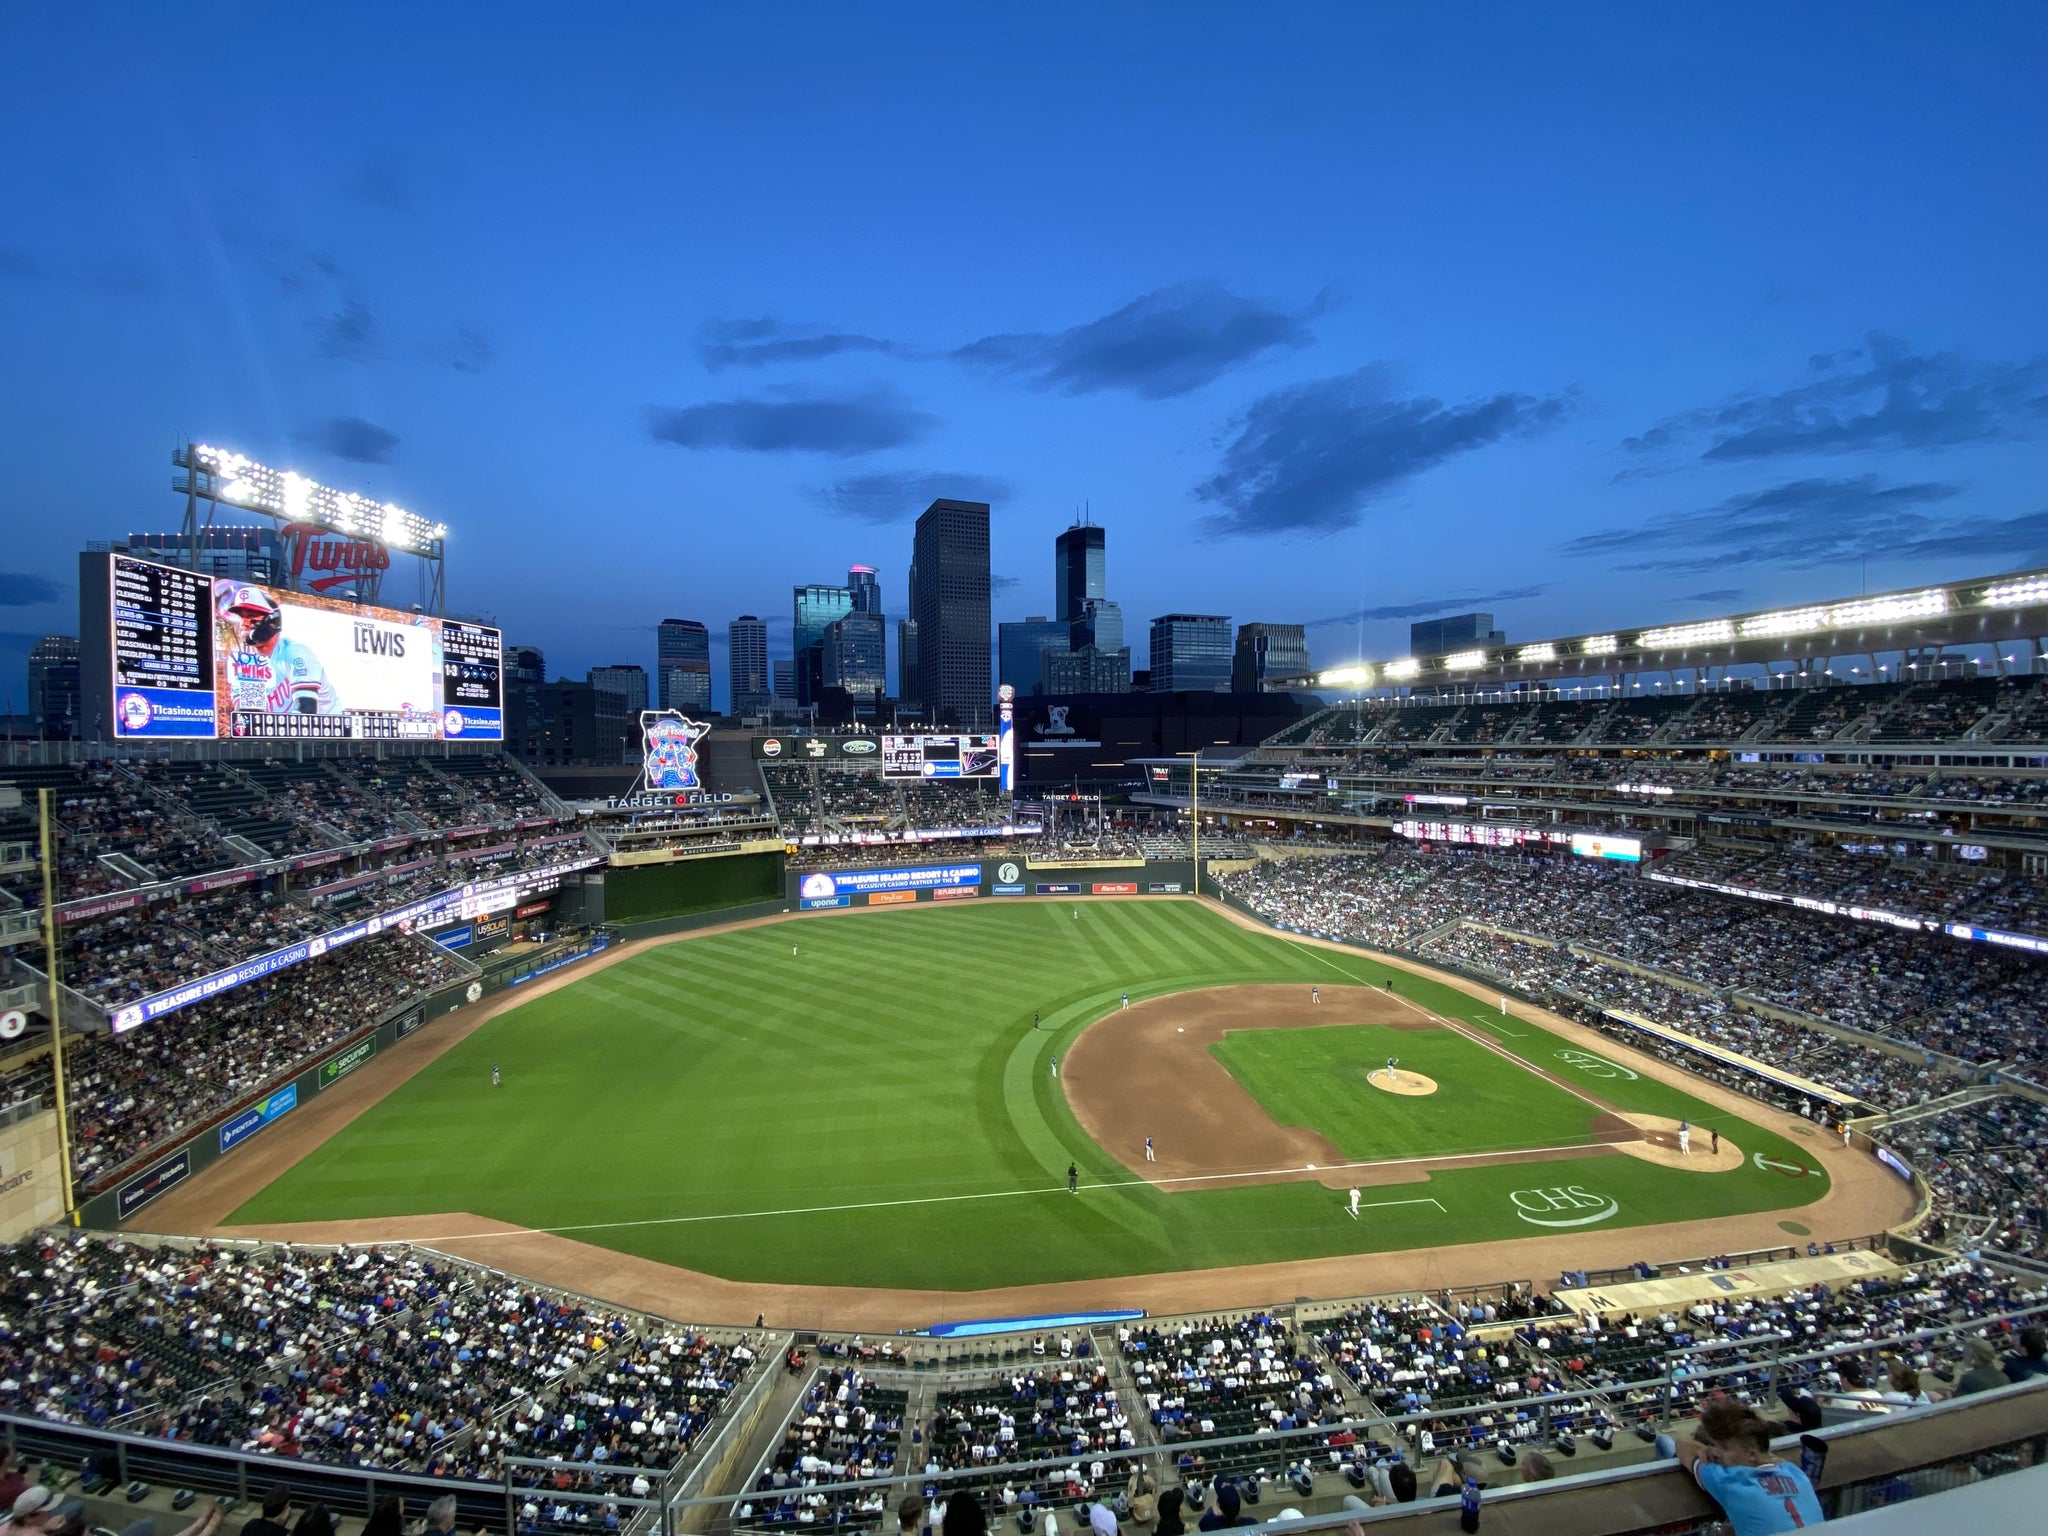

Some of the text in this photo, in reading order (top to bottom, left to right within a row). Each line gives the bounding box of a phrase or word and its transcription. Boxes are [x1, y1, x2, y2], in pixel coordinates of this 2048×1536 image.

[282, 522, 390, 576] Twins
[116, 570, 140, 580] MARTIN
[116, 580, 141, 590] BUXTON
[116, 590, 145, 600] CLEMENS
[117, 600, 132, 608] BELL
[354, 621, 374, 629] ROYCE
[117, 640, 153, 650] KEASCHALL
[354, 626, 405, 658] LEWIS
[232, 664, 272, 679] TWINS
[445, 664, 458, 677] 1-3
[152, 704, 214, 717] TIcasino.com
[255, 715, 260, 724] 1
[266, 715, 273, 724] 0
[278, 716, 285, 724] 0
[291, 716, 297, 725] 0
[302, 716, 308, 725] 0
[314, 717, 319, 725] 1
[324, 717, 330, 726] 0
[335, 718, 341, 726] 0
[255, 727, 261, 736] 1
[267, 727, 273, 736] 0
[279, 727, 286, 736] 0
[291, 727, 297, 736] 0
[302, 727, 308, 736] 0
[314, 727, 320, 736] 0
[324, 727, 330, 736] 0
[335, 729, 341, 737] 0
[849, 744, 870, 752] Ford
[609, 793, 732, 808] TARGET FIELD
[302, 854, 341, 868] Treasure Island
[202, 874, 248, 891] TIcasino.com
[836, 875, 880, 885] TREASURE
[880, 873, 910, 882] ISLAND
[911, 871, 942, 880] RESORT
[949, 869, 979, 877] CASINO
[64, 898, 135, 921] Treasure Island
[811, 898, 839, 908] uponor
[383, 911, 410, 927] TREASURE
[410, 904, 427, 916] ISLAND
[478, 925, 486, 935] US
[486, 920, 507, 931] SOLAR
[148, 948, 307, 1015] TREASURE ISLAND RESORT & CASINO
[9, 1018, 18, 1031] 3
[338, 1044, 369, 1066] securian
[231, 1116, 259, 1137] PENTAIR
[1510, 1186, 1605, 1212] CHS
[1784, 1497, 1805, 1528] 1
